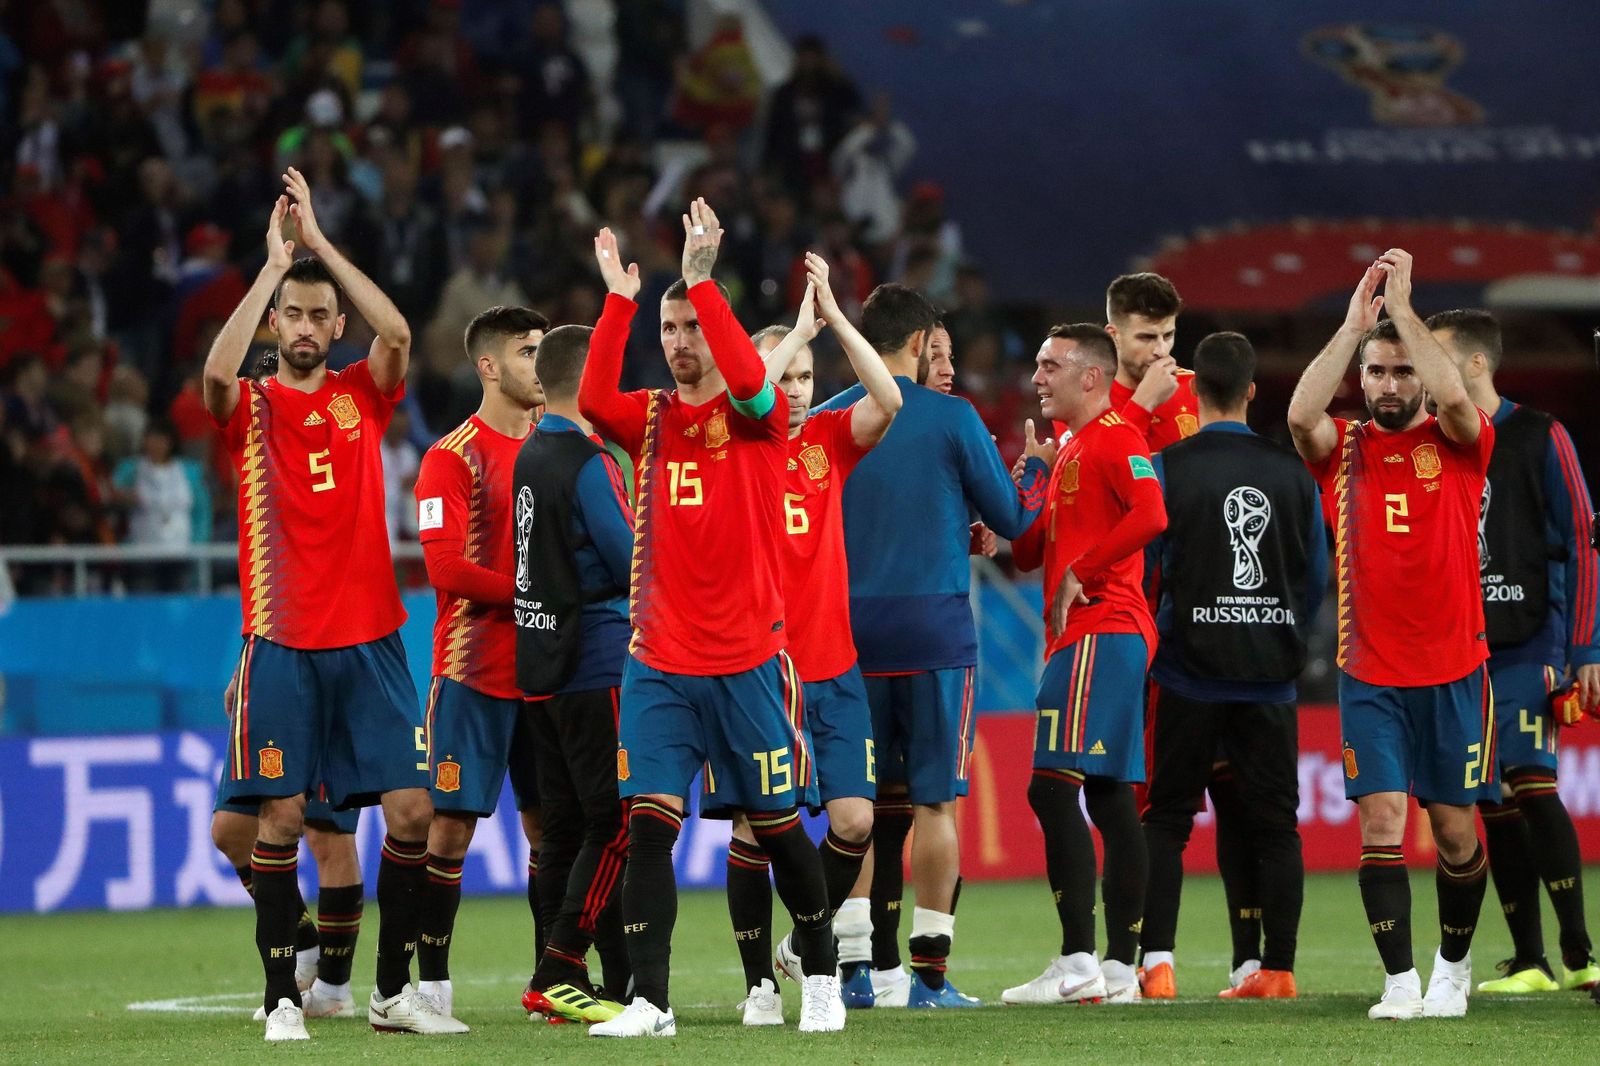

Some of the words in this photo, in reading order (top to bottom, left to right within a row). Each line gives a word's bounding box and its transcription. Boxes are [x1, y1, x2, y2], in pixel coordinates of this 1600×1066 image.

[308, 447, 336, 493] 5
[666, 462, 703, 506] 15
[784, 493, 809, 535] 6
[1385, 493, 1410, 533] 2
[1486, 585, 1524, 601] 2018
[1487, 575, 1504, 583] CUP
[527, 601, 542, 610] CUP
[1193, 607, 1260, 623] RUSSIA
[1216, 596, 1234, 605] FIFA
[1234, 596, 1262, 605] WORLD
[1262, 597, 1280, 606] CUP
[525, 612, 557, 631] 2018
[1519, 709, 1543, 750] 4
[753, 746, 792, 795] 15
[1464, 742, 1480, 788] 2
